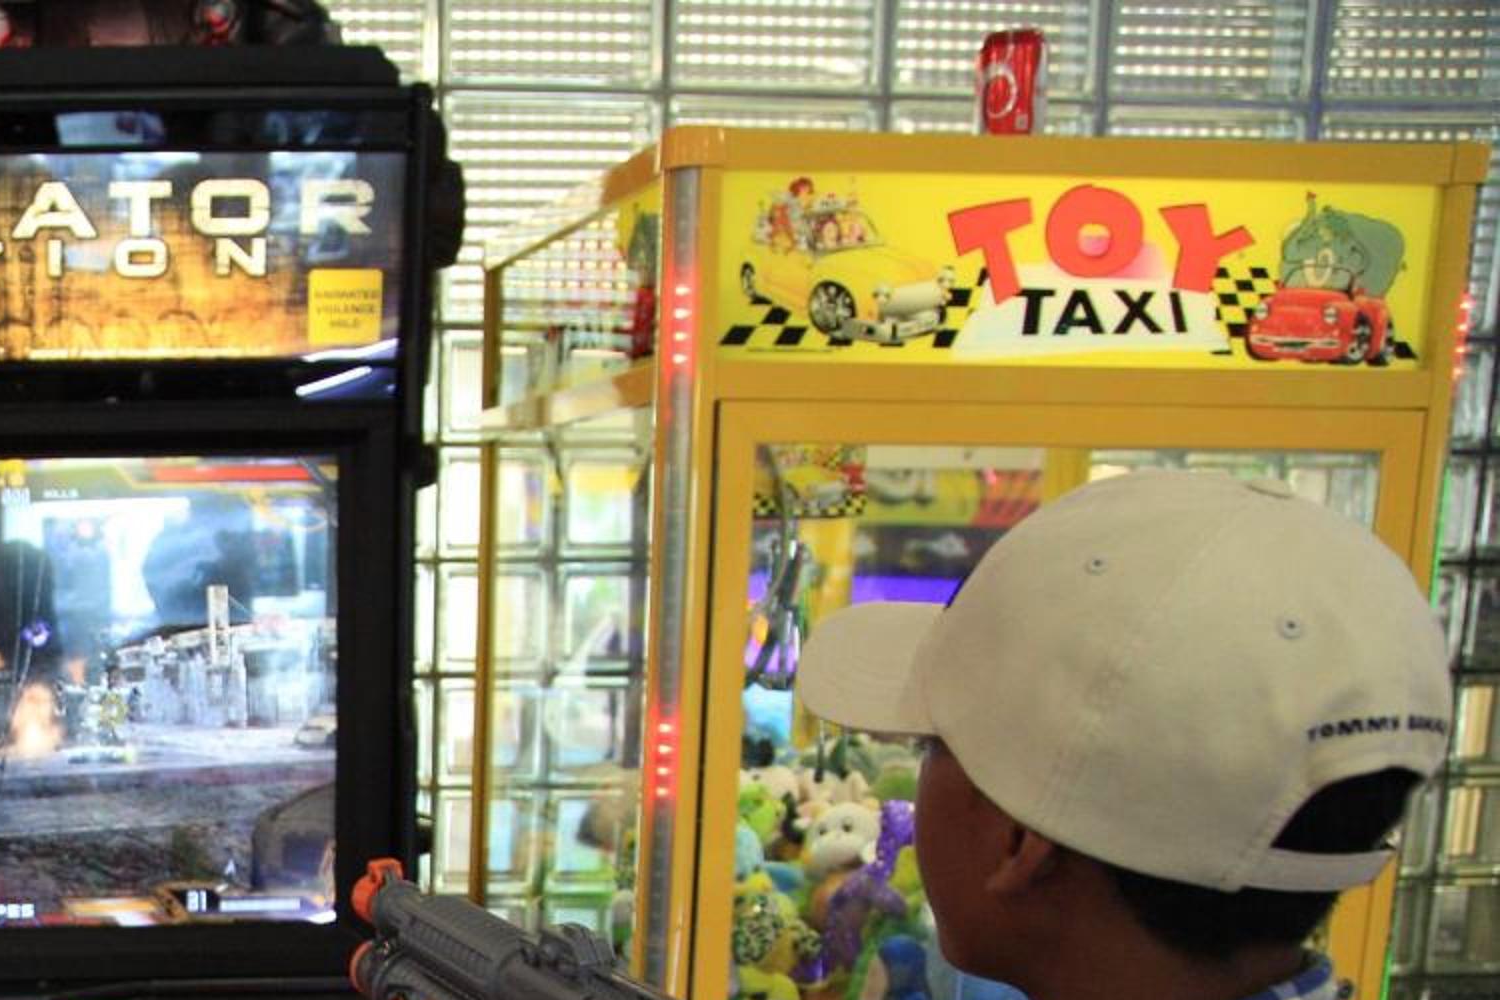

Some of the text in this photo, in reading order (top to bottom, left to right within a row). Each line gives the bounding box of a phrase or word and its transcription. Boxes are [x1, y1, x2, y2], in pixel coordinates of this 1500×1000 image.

[947, 183, 1256, 305] TOY
[1017, 288, 1188, 335] TAXI
[1308, 715, 1399, 742] TOMMY
